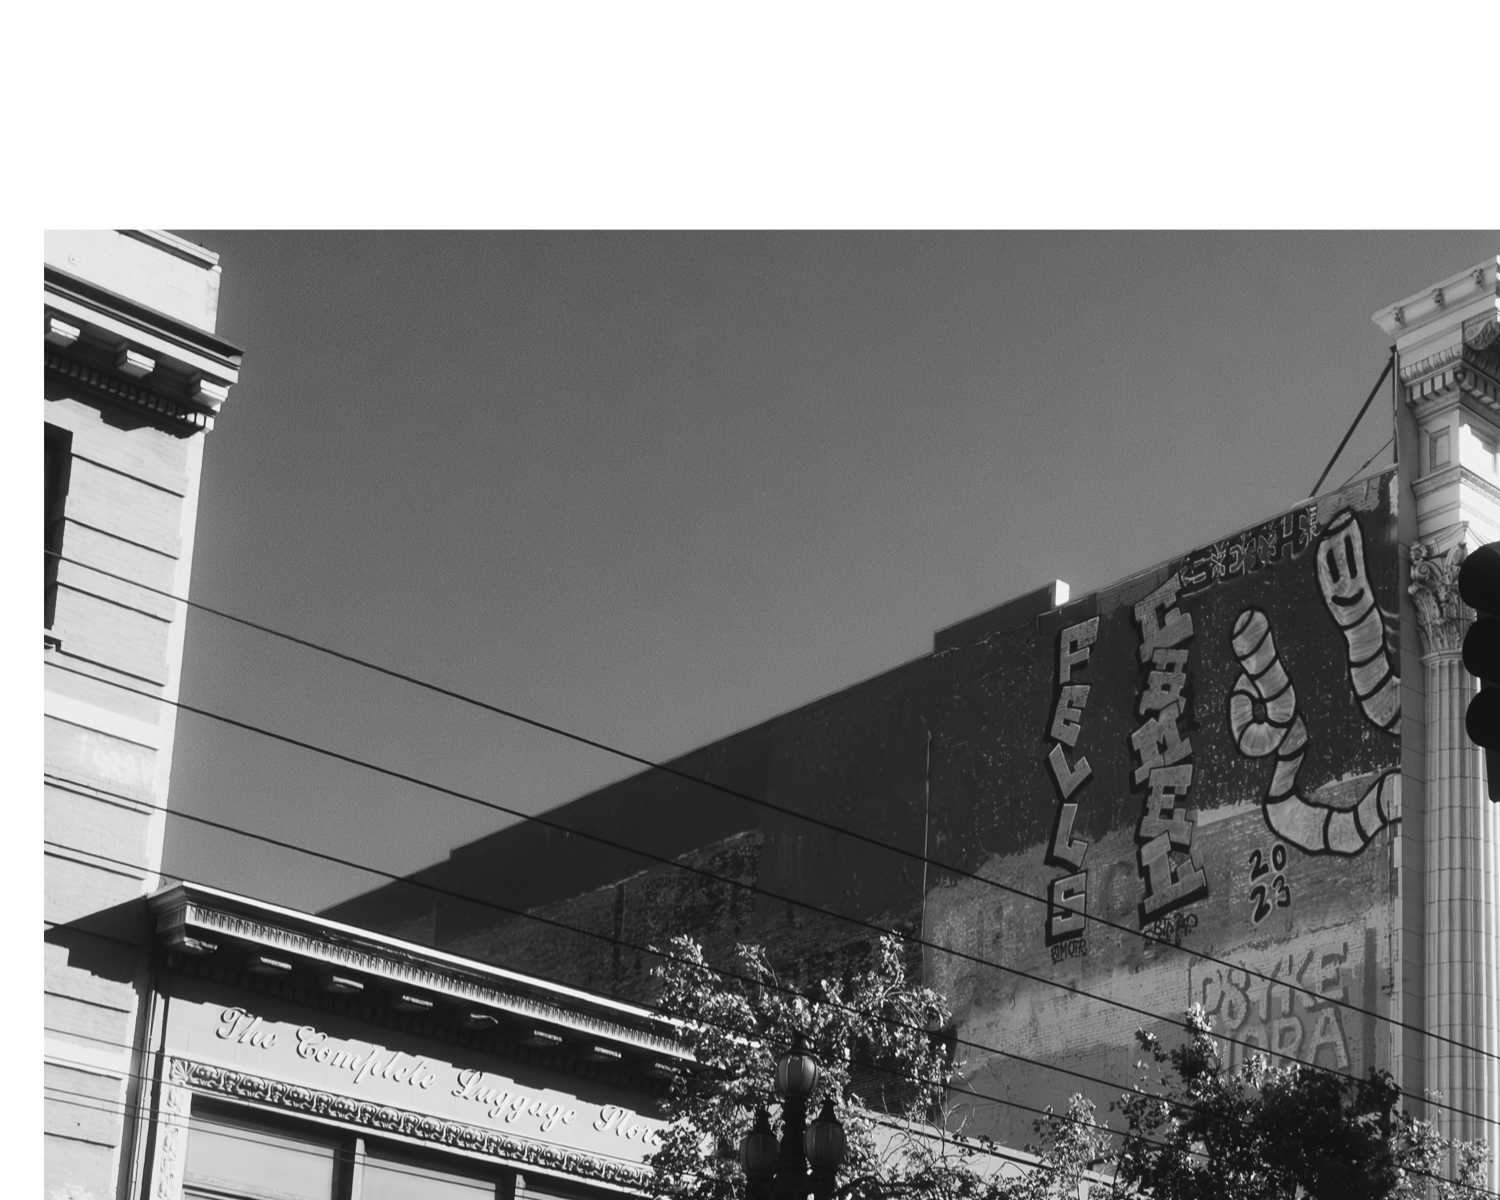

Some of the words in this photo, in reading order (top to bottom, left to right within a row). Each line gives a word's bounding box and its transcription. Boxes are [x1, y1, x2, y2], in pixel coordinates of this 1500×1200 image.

[1249, 844, 1288, 880] 20
[1250, 875, 1291, 923] 23
[216, 1007, 276, 1051] The
[295, 1023, 438, 1090] Complete
[451, 1067, 578, 1132] Luggage
